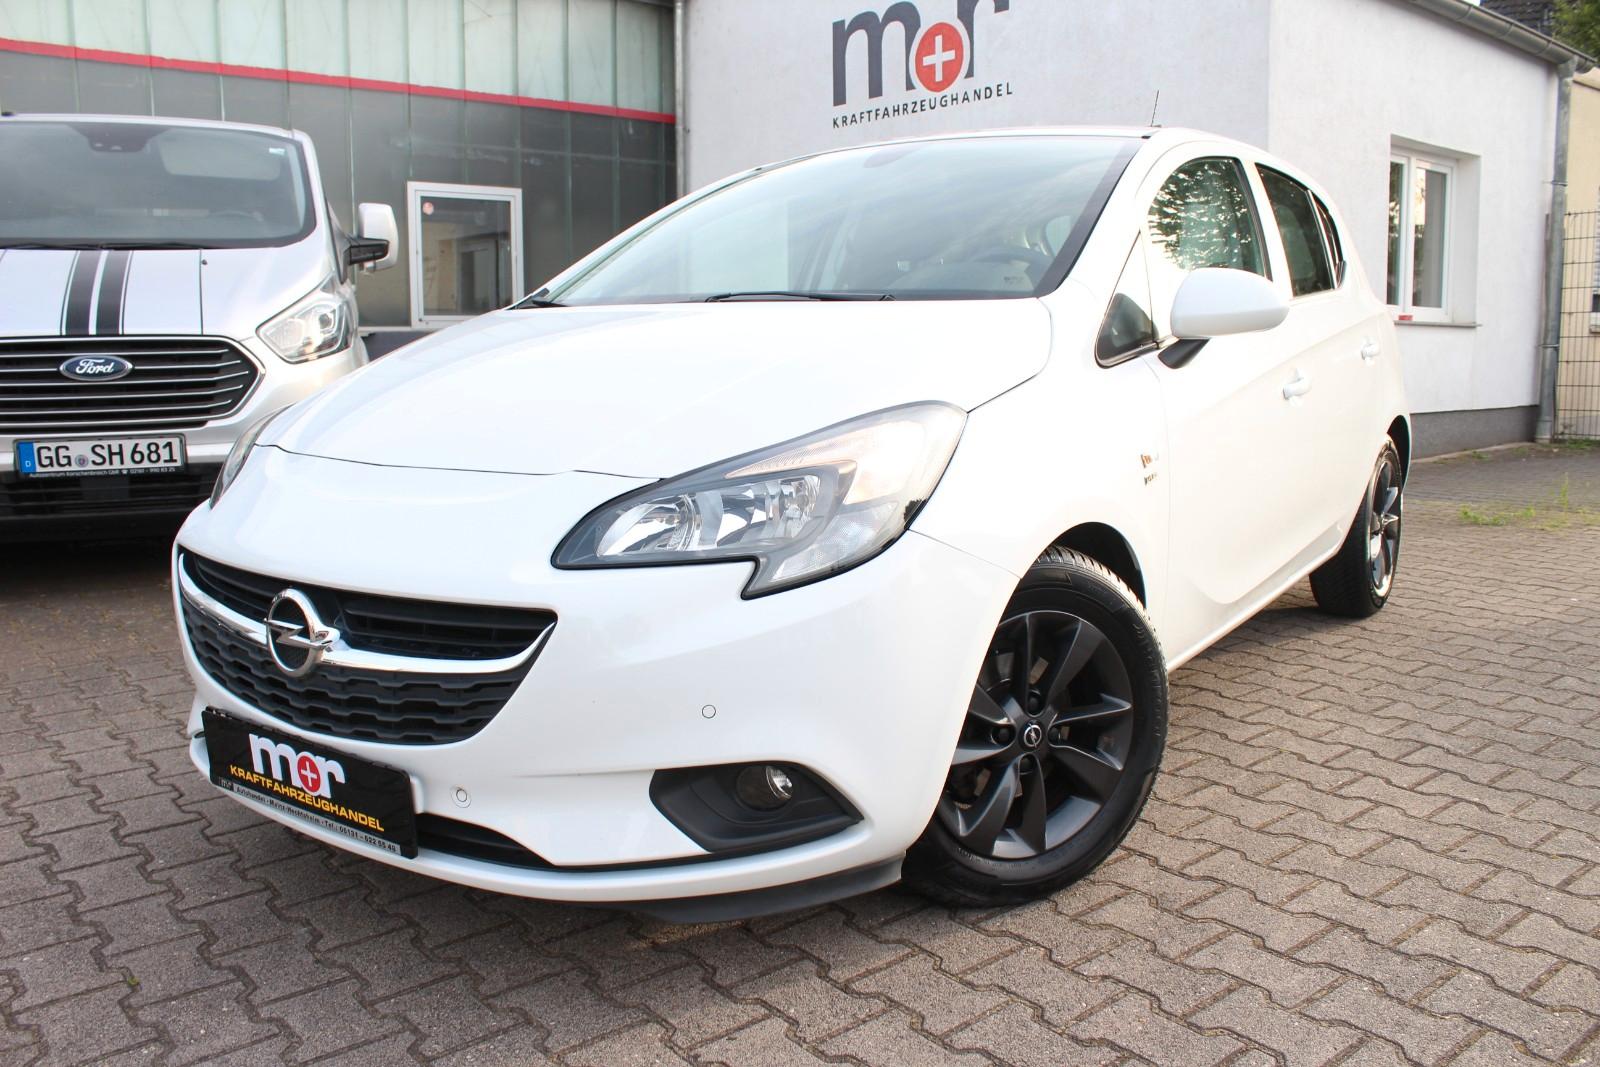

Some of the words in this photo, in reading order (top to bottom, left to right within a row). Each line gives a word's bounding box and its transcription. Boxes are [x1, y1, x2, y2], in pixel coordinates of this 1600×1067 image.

[832, 82, 1013, 129] KRAFTFAHRZEUGHANDEL
[75, 358, 114, 375] Ford
[36, 445, 73, 468] GG
[90, 443, 125, 466] SH
[130, 441, 178, 465] 681
[230, 764, 385, 832] KRAFTFAHRZEUGHANDEL
